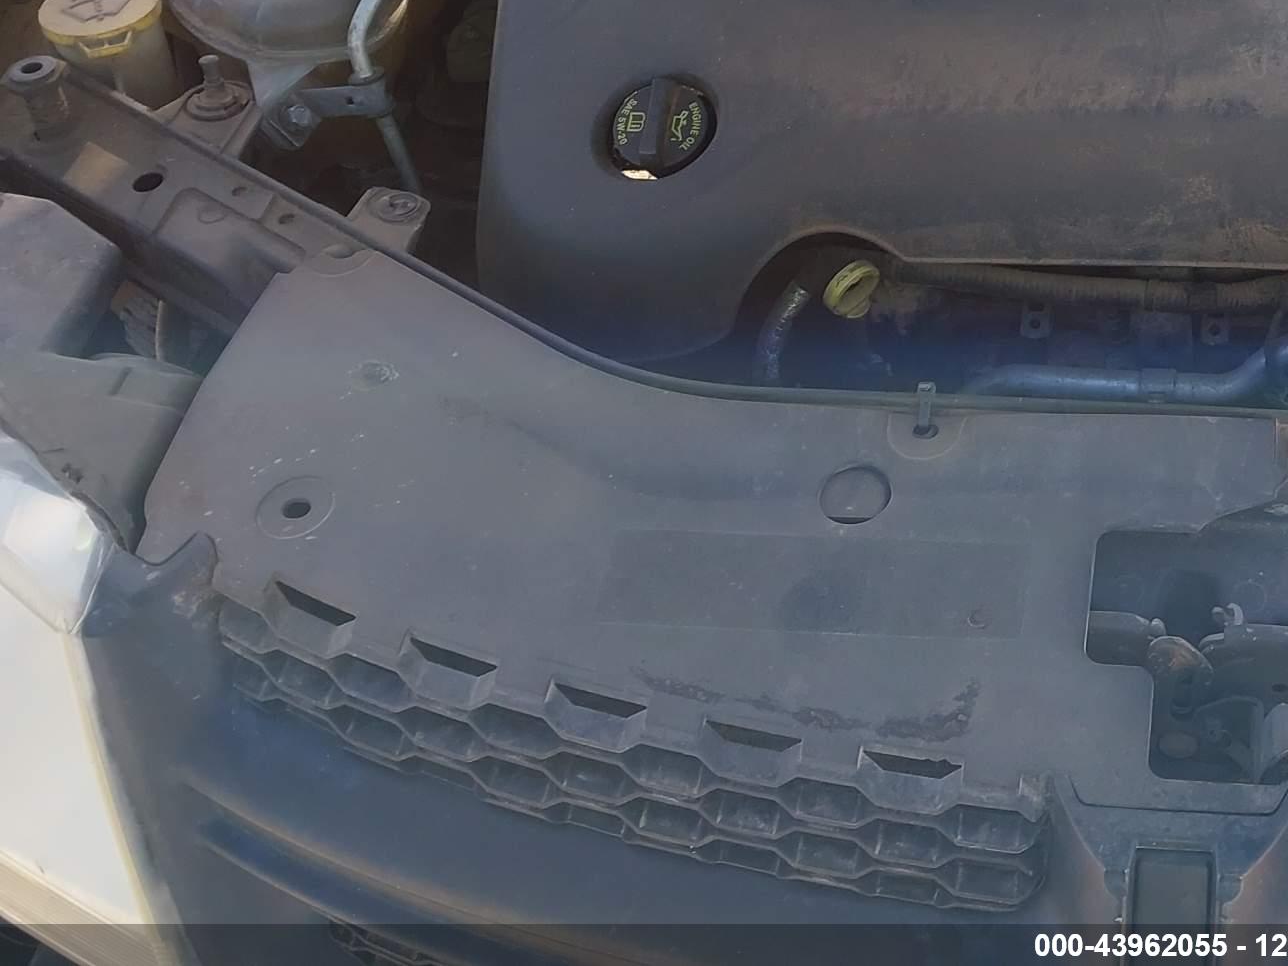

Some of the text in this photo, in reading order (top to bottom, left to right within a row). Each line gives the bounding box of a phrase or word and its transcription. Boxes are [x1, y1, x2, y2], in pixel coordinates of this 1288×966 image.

[620, 98, 638, 116] SAE
[679, 102, 702, 151] ENGINE OIL
